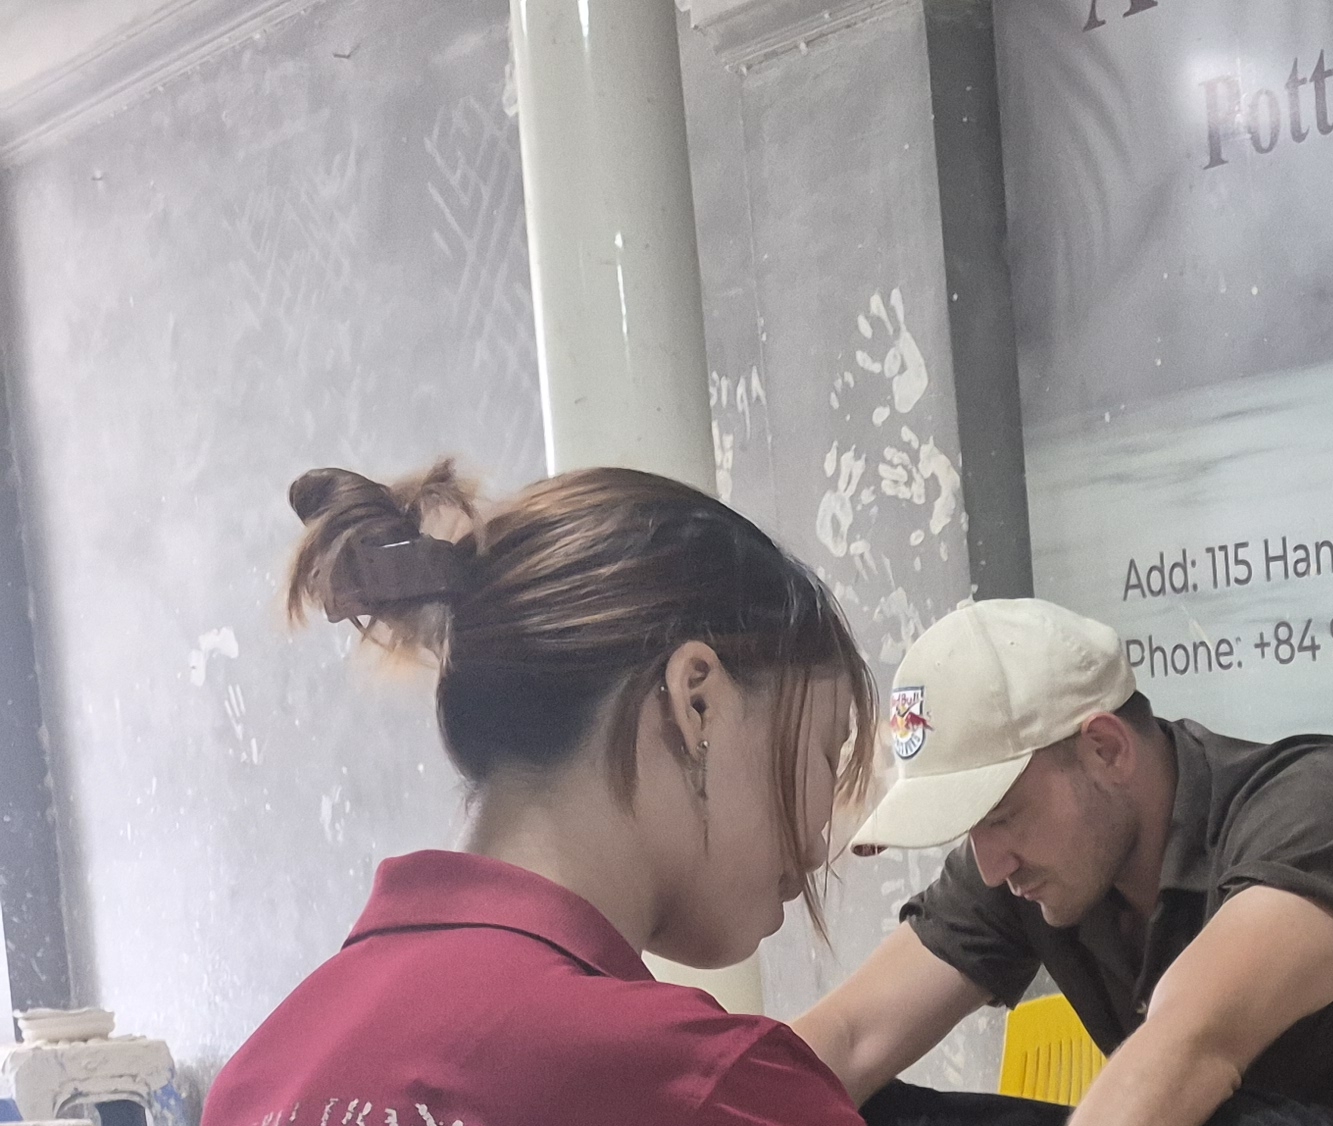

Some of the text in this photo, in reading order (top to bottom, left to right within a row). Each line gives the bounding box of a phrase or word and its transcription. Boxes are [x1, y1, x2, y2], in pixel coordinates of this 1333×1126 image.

[1122, 548, 1199, 602] Add:
[1204, 541, 1253, 589] 115
[1125, 634, 1243, 678] Phone:
[1254, 618, 1321, 663] +84
